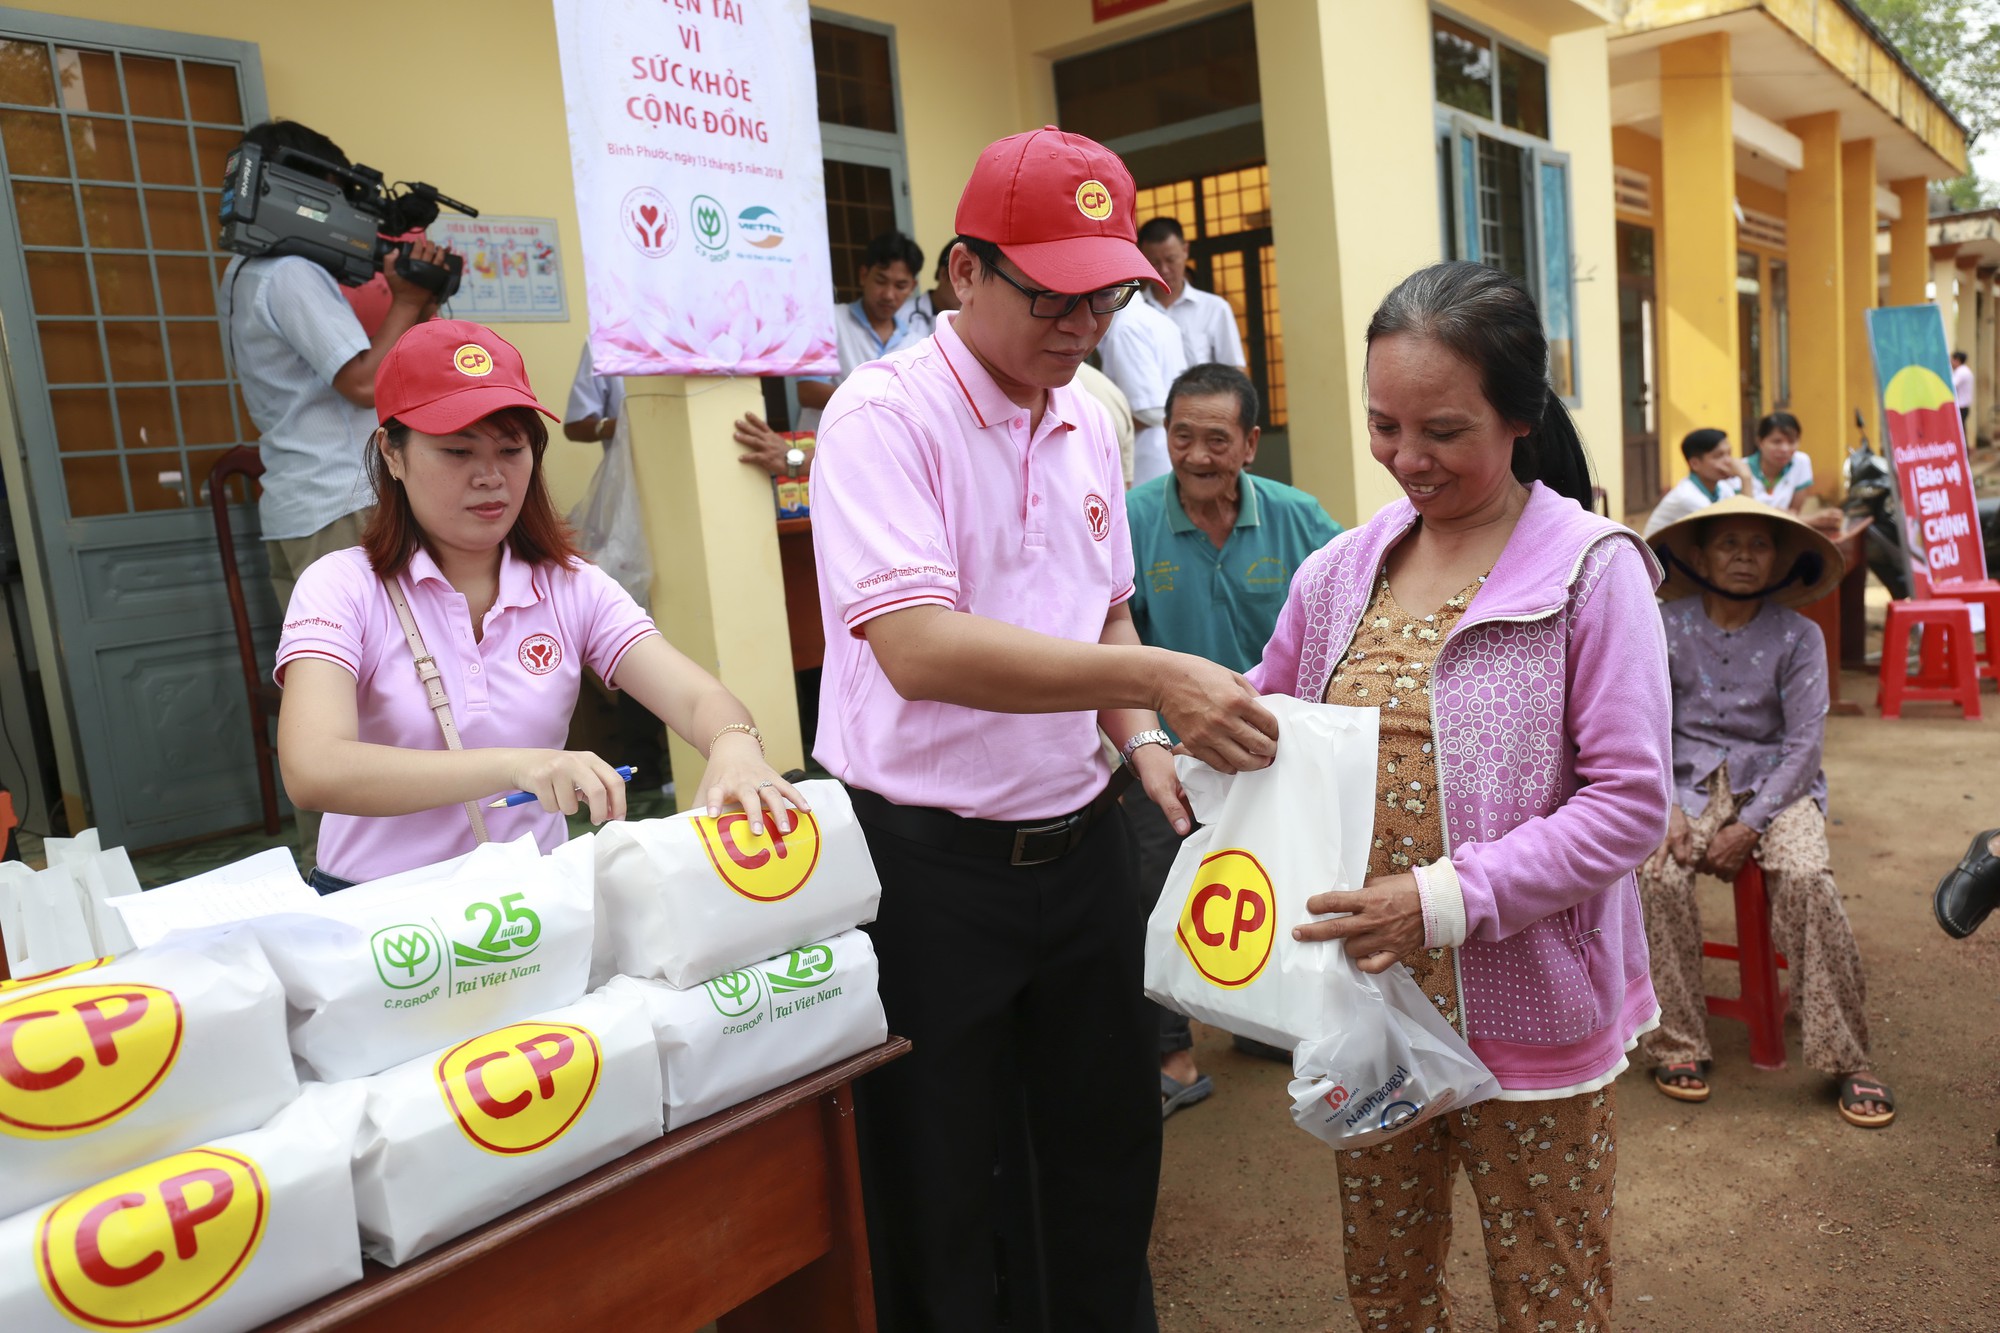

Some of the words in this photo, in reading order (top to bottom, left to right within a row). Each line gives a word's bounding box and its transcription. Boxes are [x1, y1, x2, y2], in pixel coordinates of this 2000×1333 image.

[678, 24, 701, 53] VÌ
[631, 54, 685, 88] SỨC
[689, 68, 752, 103] KHỎE
[626, 93, 697, 129] CỘNG
[702, 107, 768, 143] ĐỒNG
[607, 143, 635, 157] Bình
[636, 145, 673, 161] Phước,
[674, 151, 696, 167] ngày
[697, 155, 708, 168] 13
[708, 159, 736, 175] tháng
[737, 162, 743, 173] 5
[744, 162, 764, 176] năm
[764, 167, 785, 180] 2018
[1082, 192, 1107, 209] CP
[738, 222, 784, 234] VIETTEL
[460, 353, 486, 369] CP
[1915, 463, 1944, 488] Bảo
[1919, 489, 1950, 515] SIM
[1924, 512, 1970, 542] CHÍNH
[1929, 537, 1960, 570] CHỦ
[717, 809, 799, 869] CP
[465, 892, 541, 953] 25
[501, 925, 523, 938] năm
[1191, 883, 1266, 951] CP
[802, 953, 820, 967] năm
[456, 977, 477, 995] Tại
[481, 970, 507, 988] Việt
[509, 963, 541, 981] Nam
[775, 1001, 793, 1019] Tại
[795, 995, 815, 1012] Việt
[817, 986, 842, 1004] Nam
[0, 993, 149, 1091] CP
[463, 1032, 575, 1119] CP
[1345, 1064, 1409, 1128] Naphacogyl
[1325, 1108, 1345, 1123] NAMHA
[75, 1168, 234, 1288] CP
